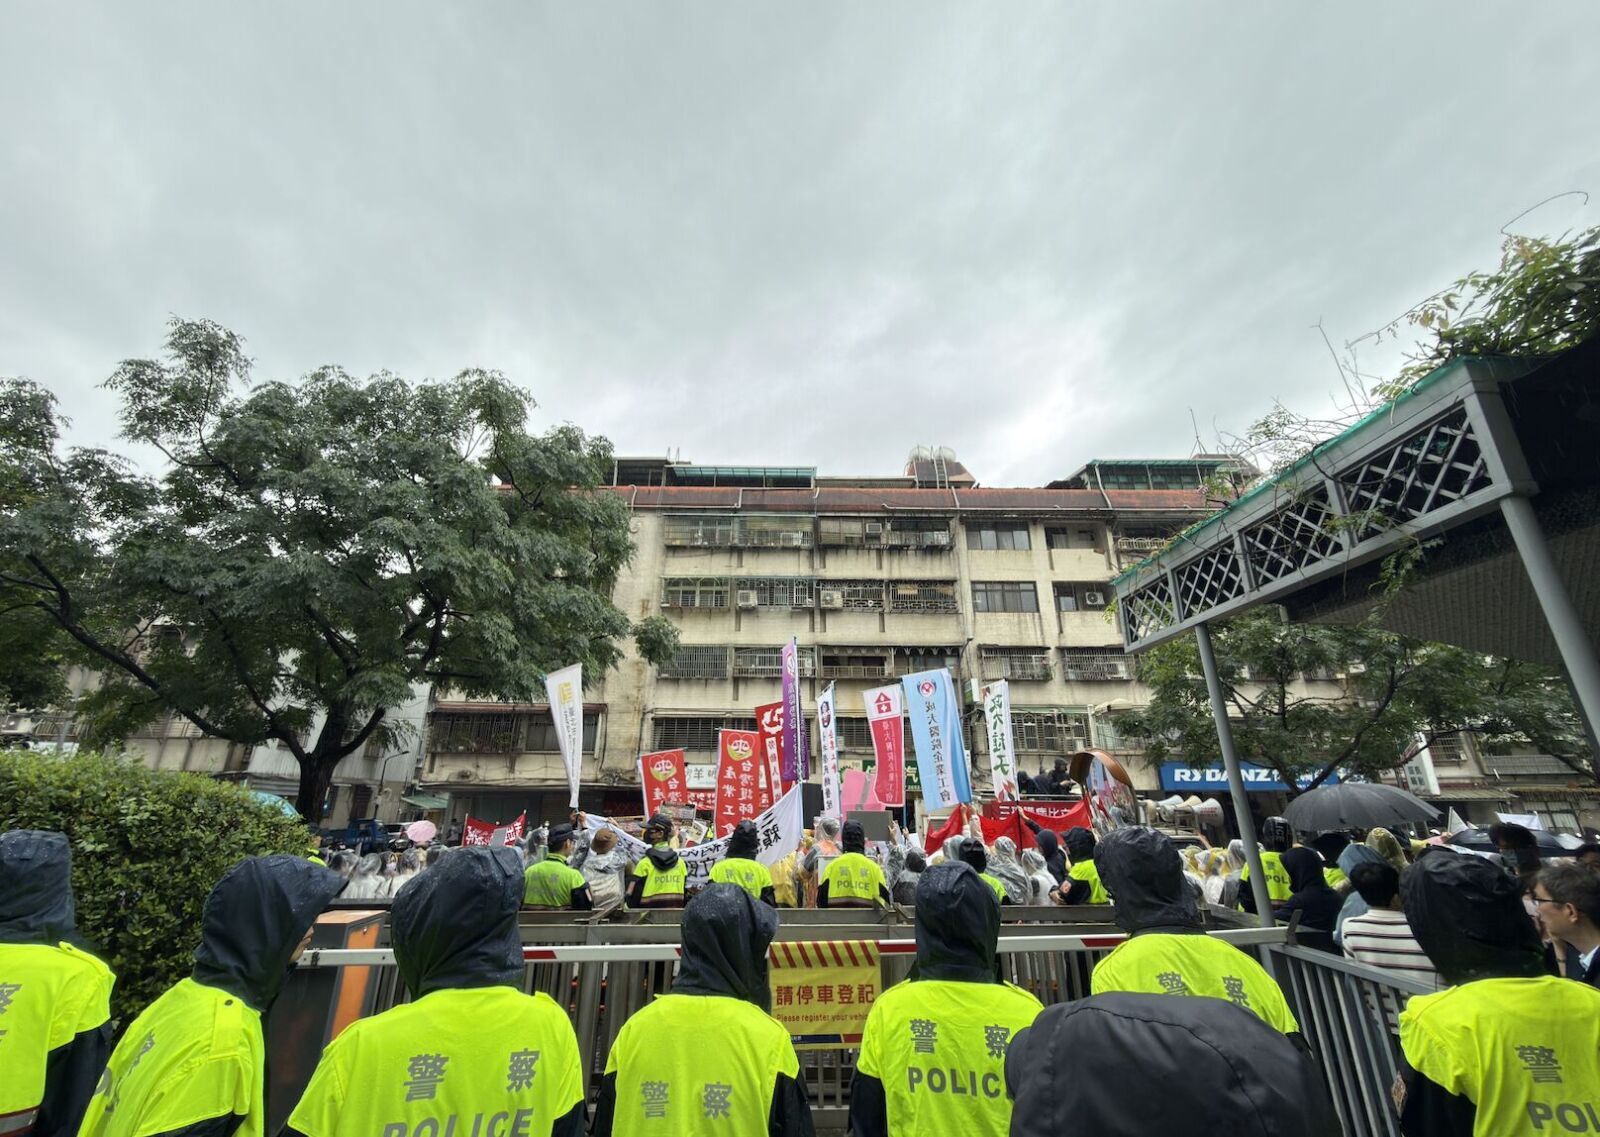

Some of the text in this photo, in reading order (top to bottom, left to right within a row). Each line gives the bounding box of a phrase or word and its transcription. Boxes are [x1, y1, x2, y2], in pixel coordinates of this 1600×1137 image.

[654, 874, 681, 885] POLICE
[837, 880, 870, 891] POLICE
[775, 983, 875, 1006] 請停車登記
[776, 1013, 800, 1023] Please
[801, 1013, 830, 1023] register
[831, 1014, 847, 1023] your
[909, 1018, 1011, 1059] 警察
[403, 1047, 541, 1102] 警察
[1514, 1045, 1563, 1083] 警
[907, 1066, 1001, 1099] POLIC
[640, 1080, 733, 1120] 警察
